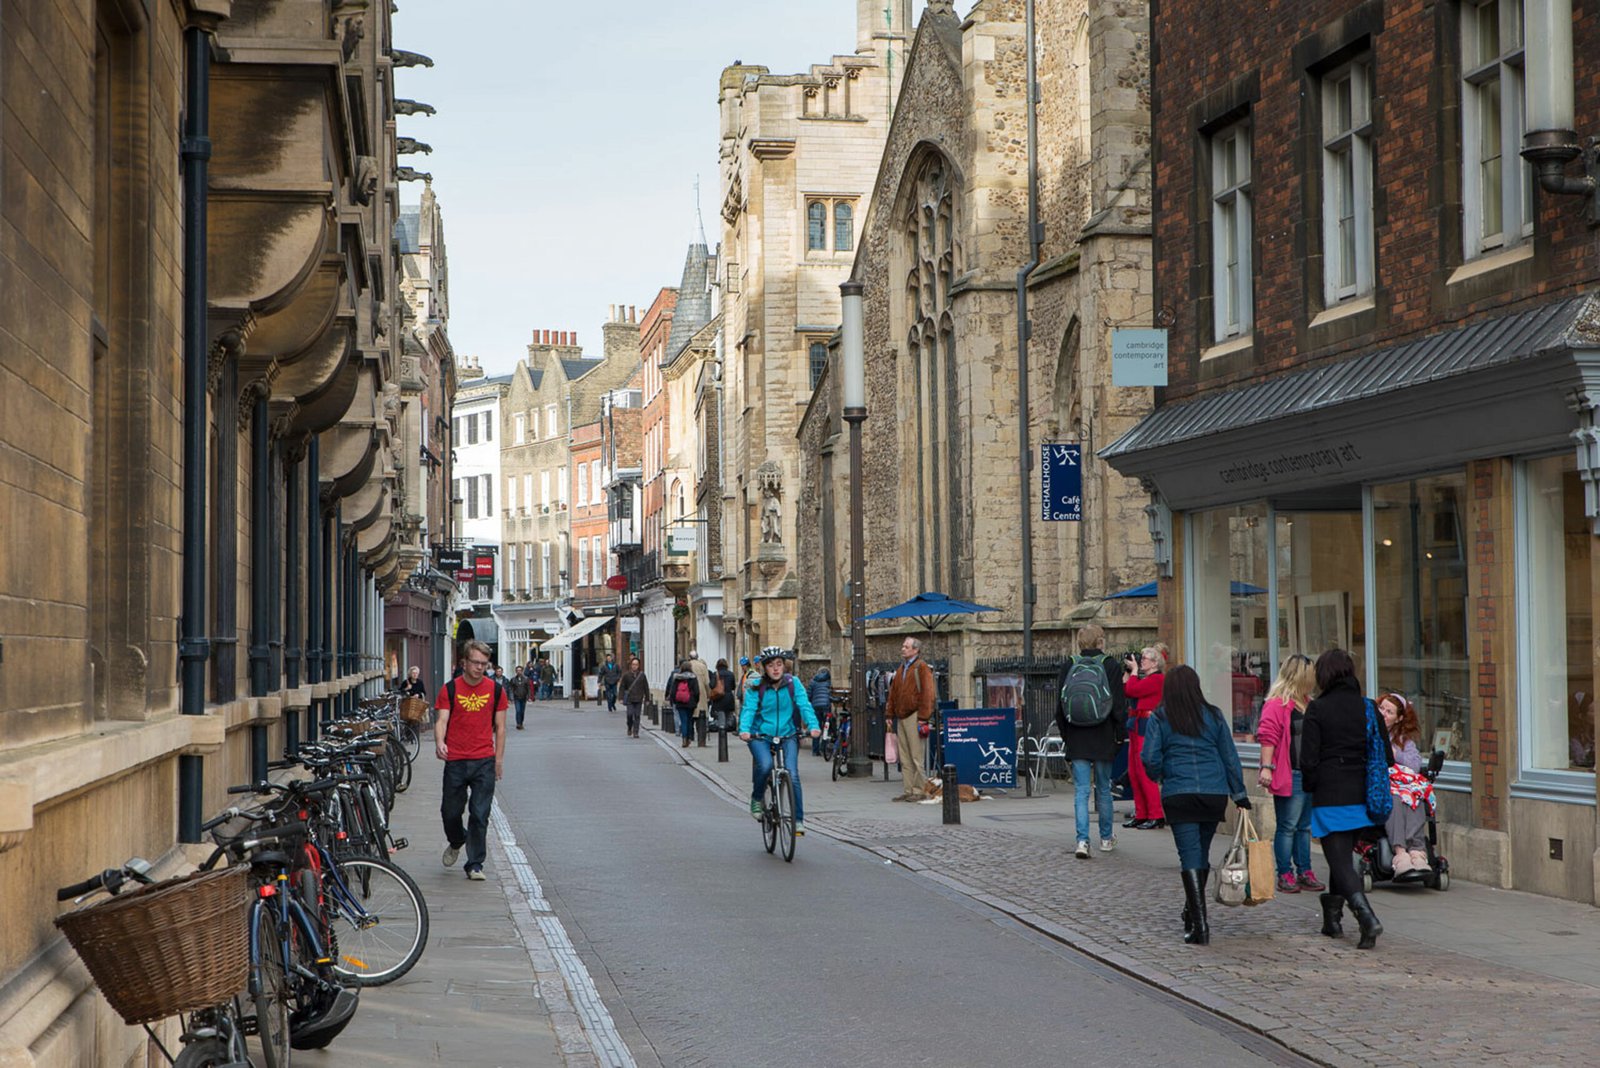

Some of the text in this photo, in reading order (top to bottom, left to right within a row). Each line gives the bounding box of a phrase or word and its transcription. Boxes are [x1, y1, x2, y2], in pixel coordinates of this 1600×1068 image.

[1126, 342, 1164, 350] cambridge
[1114, 352, 1164, 360] contemporary
[1219, 441, 1362, 482] cambridge contemporary art
[1042, 446, 1051, 520] MICHAELHOUSE
[1061, 496, 1080, 505] Café
[1073, 504, 1080, 512] &
[1053, 512, 1080, 520] Centre
[979, 770, 1012, 784] CAFÉ
